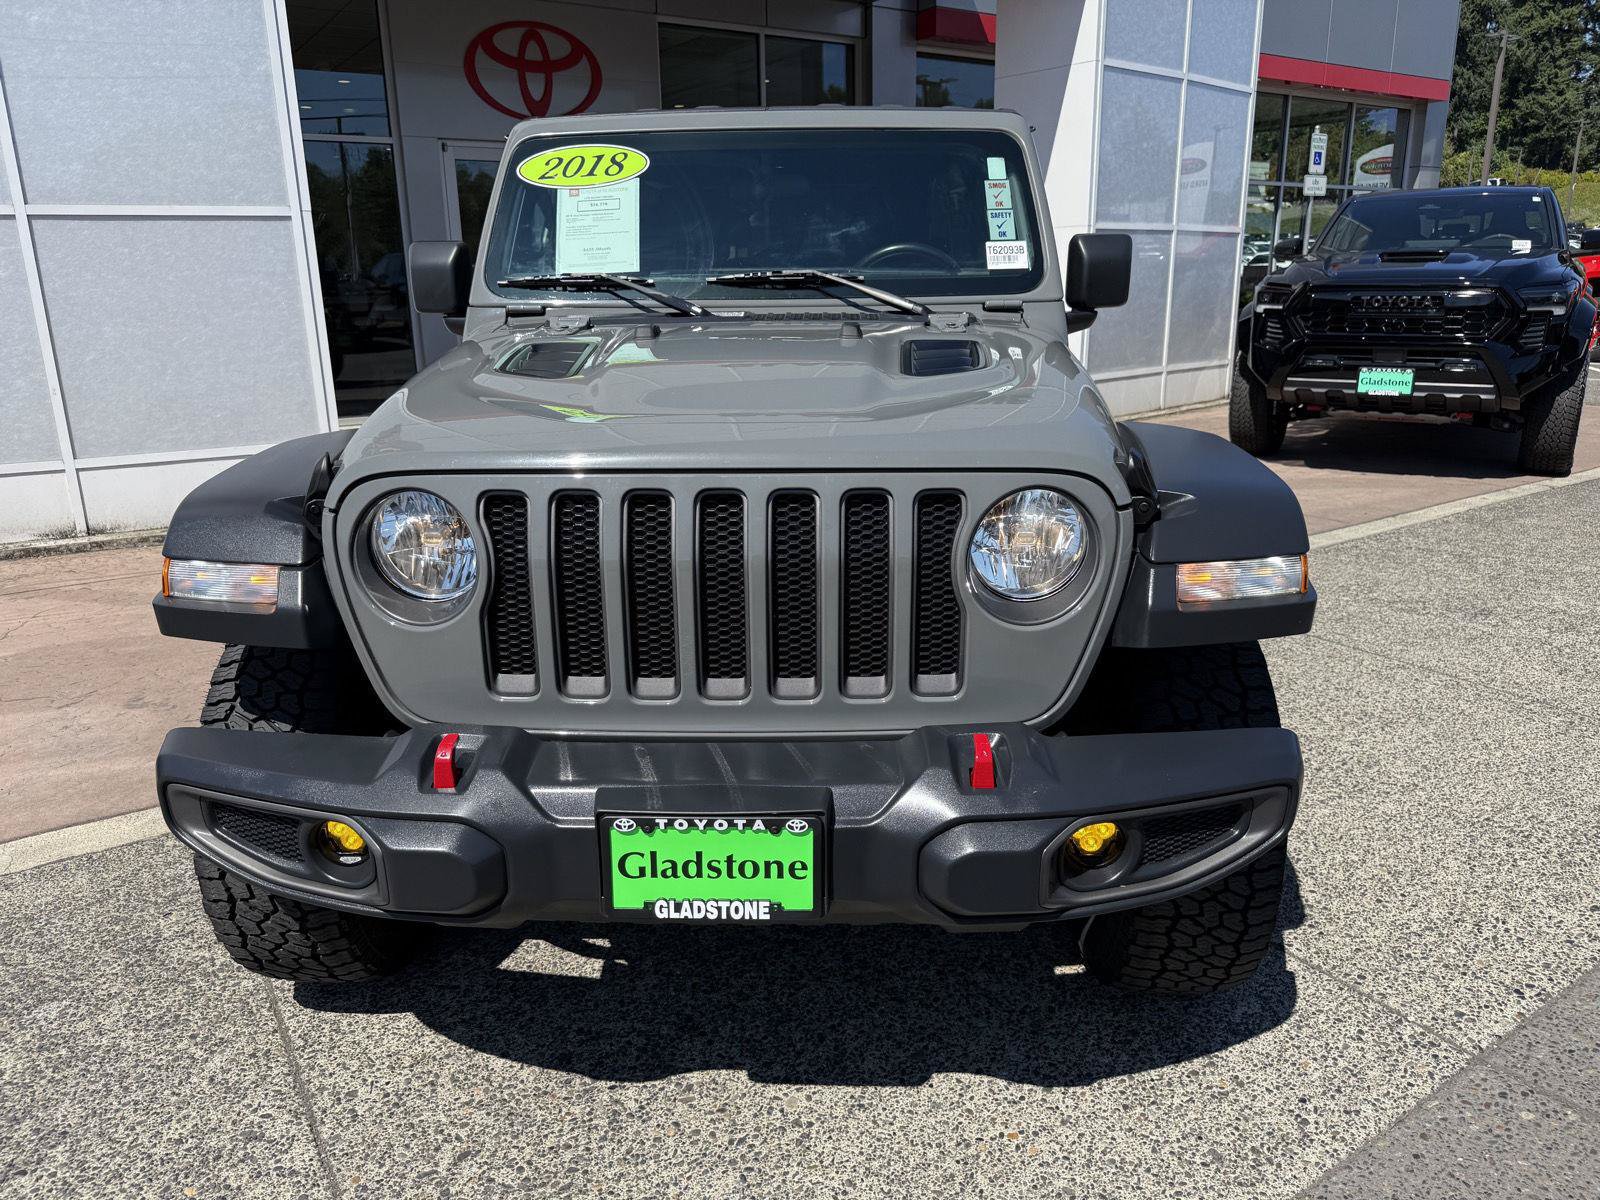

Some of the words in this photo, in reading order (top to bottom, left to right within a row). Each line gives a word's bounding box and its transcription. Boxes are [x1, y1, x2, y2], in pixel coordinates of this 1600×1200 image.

[538, 152, 629, 180] 2018
[987, 245, 1025, 255] T62093B
[1361, 296, 1432, 308] TOYOTA
[1360, 377, 1411, 387] Gladstone
[655, 818, 766, 831] TOYOTA
[617, 850, 809, 880] Gladstone
[655, 899, 771, 920] GLADSTONE
